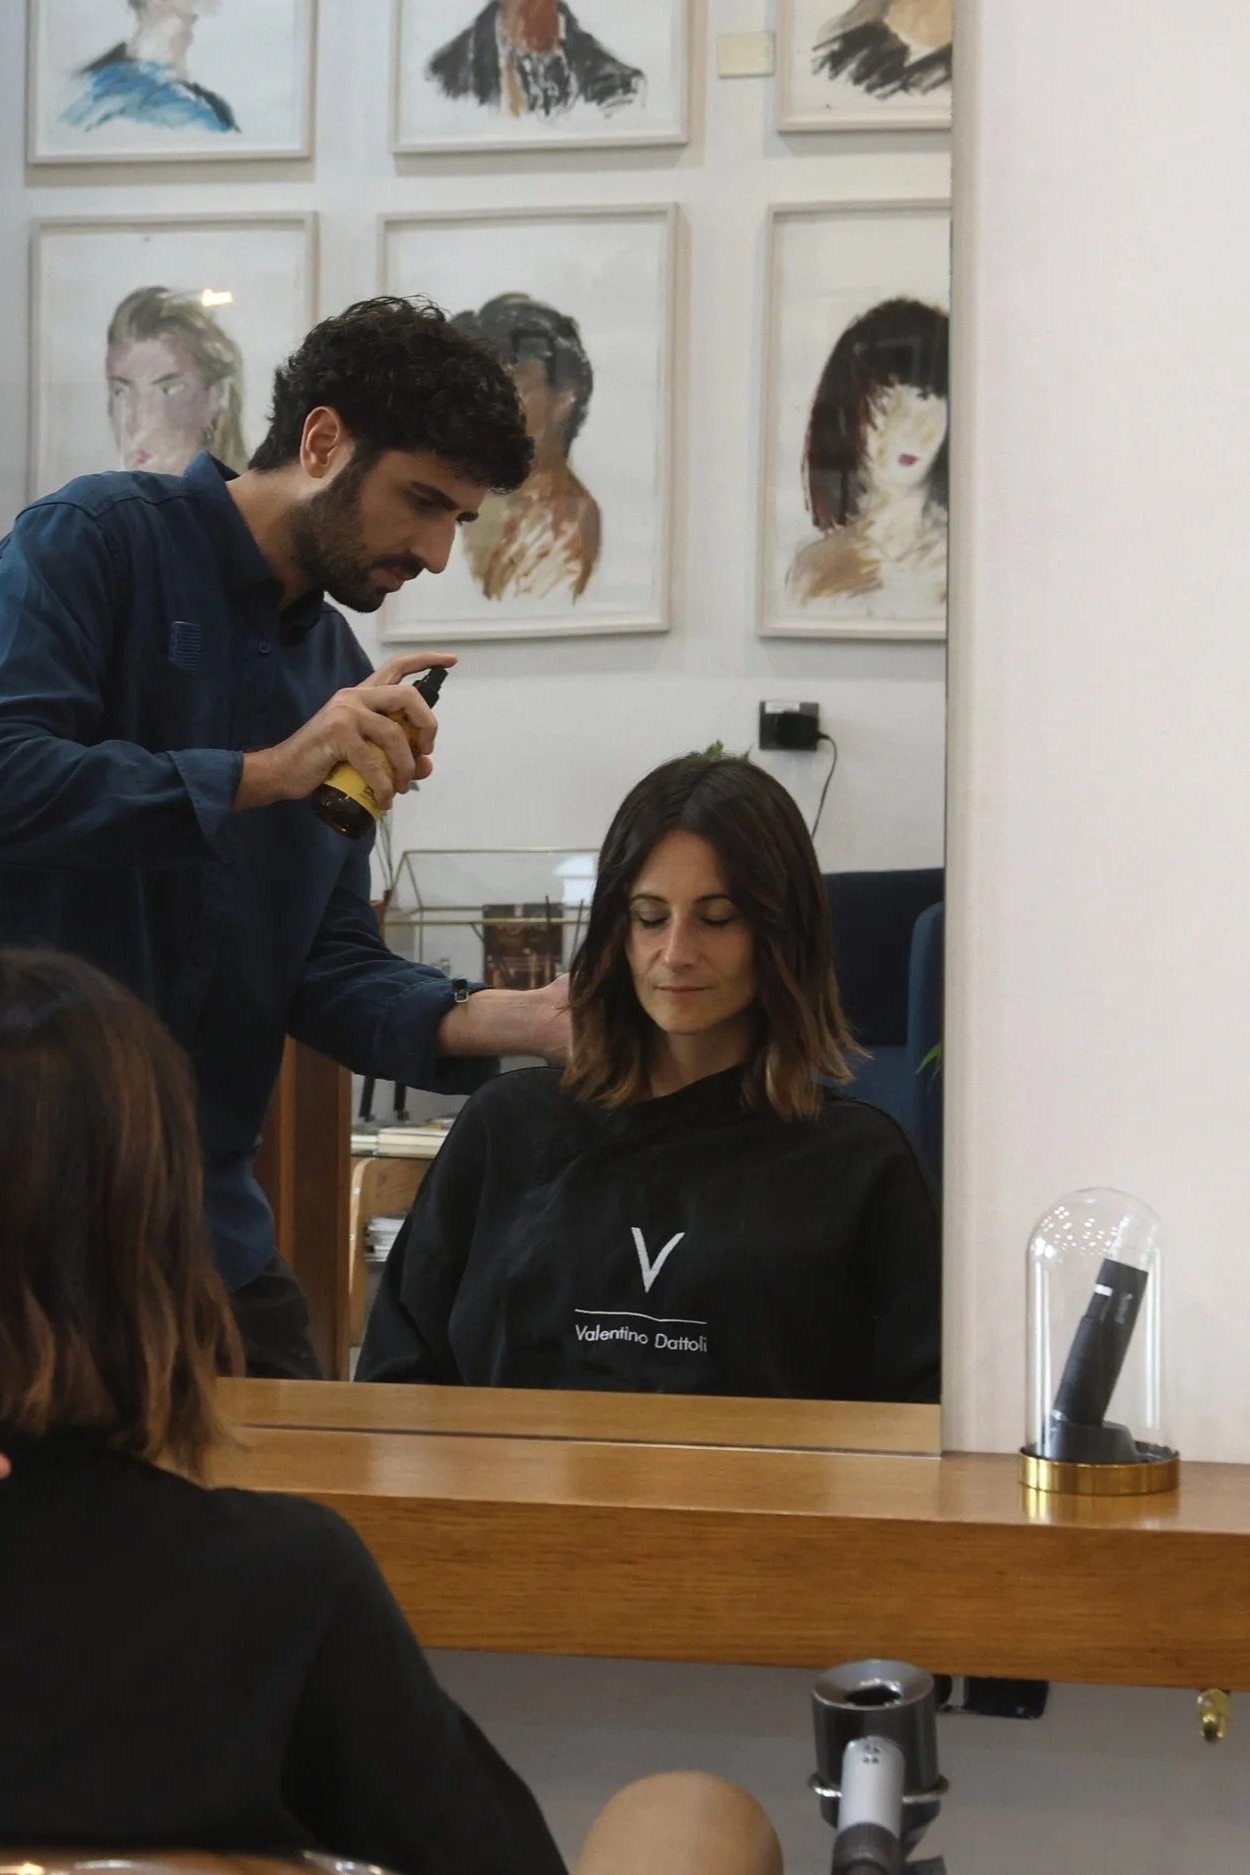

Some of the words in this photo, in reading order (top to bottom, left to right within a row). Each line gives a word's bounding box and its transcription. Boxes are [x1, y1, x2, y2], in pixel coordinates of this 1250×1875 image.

[631, 1226, 686, 1293] V
[575, 1324, 649, 1345] Valentino
[654, 1332, 708, 1353] Dattoli
